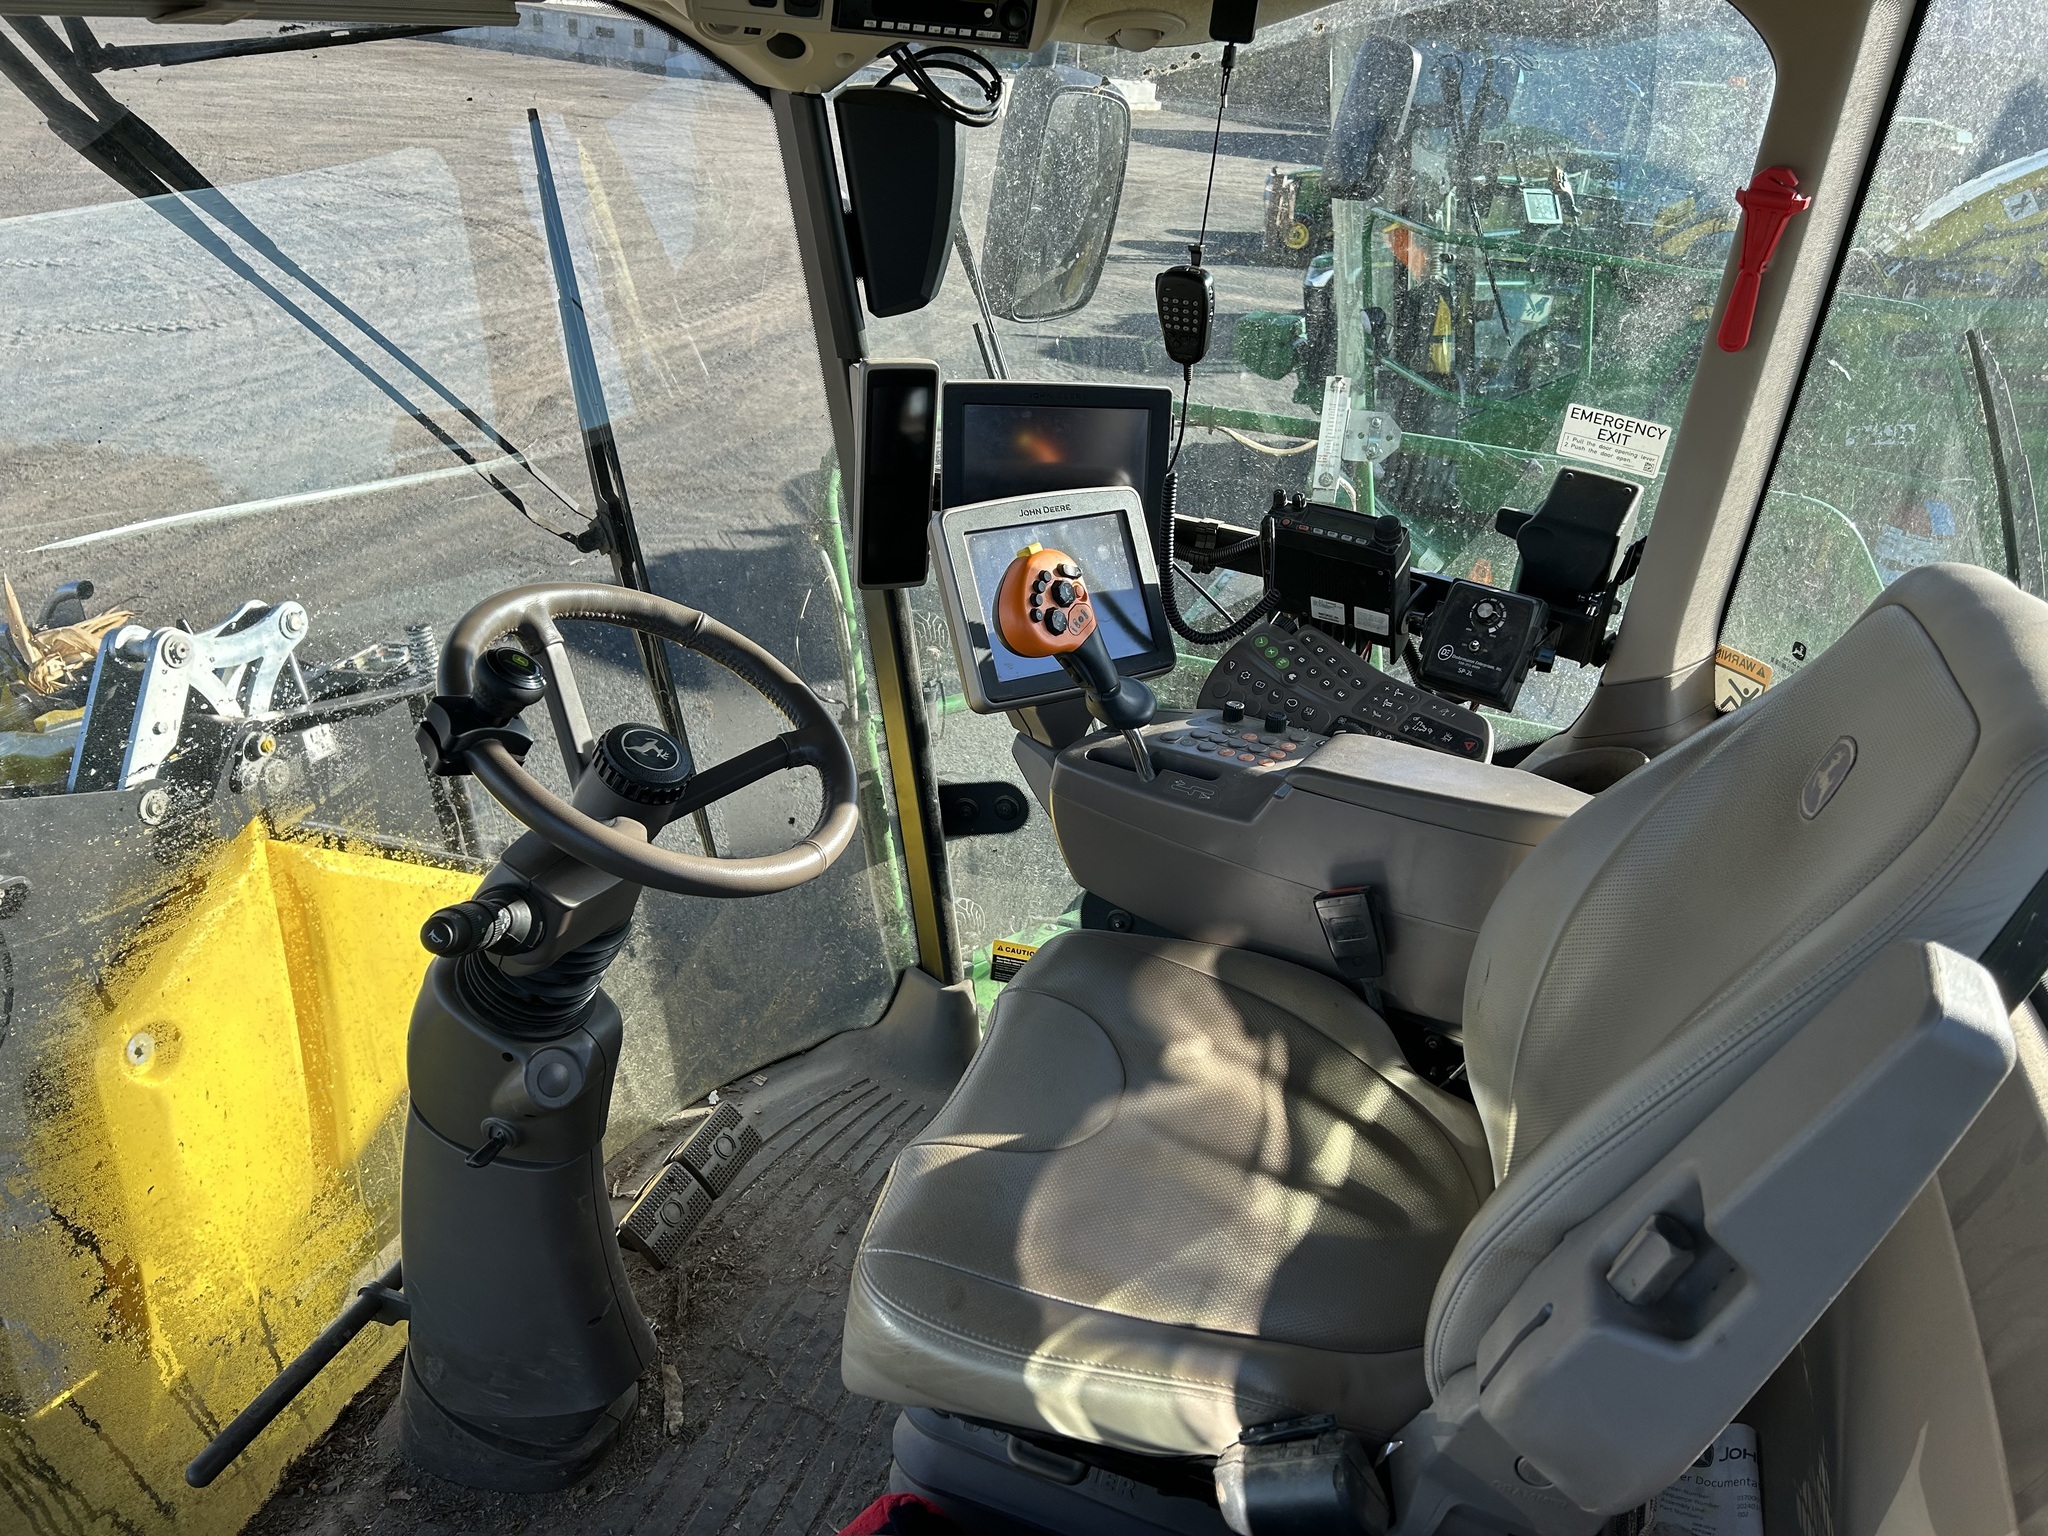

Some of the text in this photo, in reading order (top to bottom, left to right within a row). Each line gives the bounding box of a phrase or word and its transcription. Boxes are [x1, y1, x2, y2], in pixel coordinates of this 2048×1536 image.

[1570, 407, 1667, 440] EMERGENCY
[1597, 428, 1632, 446] EXIT
[1570, 442, 1586, 452] Push
[1588, 447, 1598, 455] the
[1600, 451, 1614, 459] door
[1572, 436, 1585, 445] Pull
[1598, 444, 1613, 452] door
[1614, 448, 1639, 459] opening
[1640, 454, 1656, 462] lever
[1019, 504, 1072, 517] JOHN DEERE
